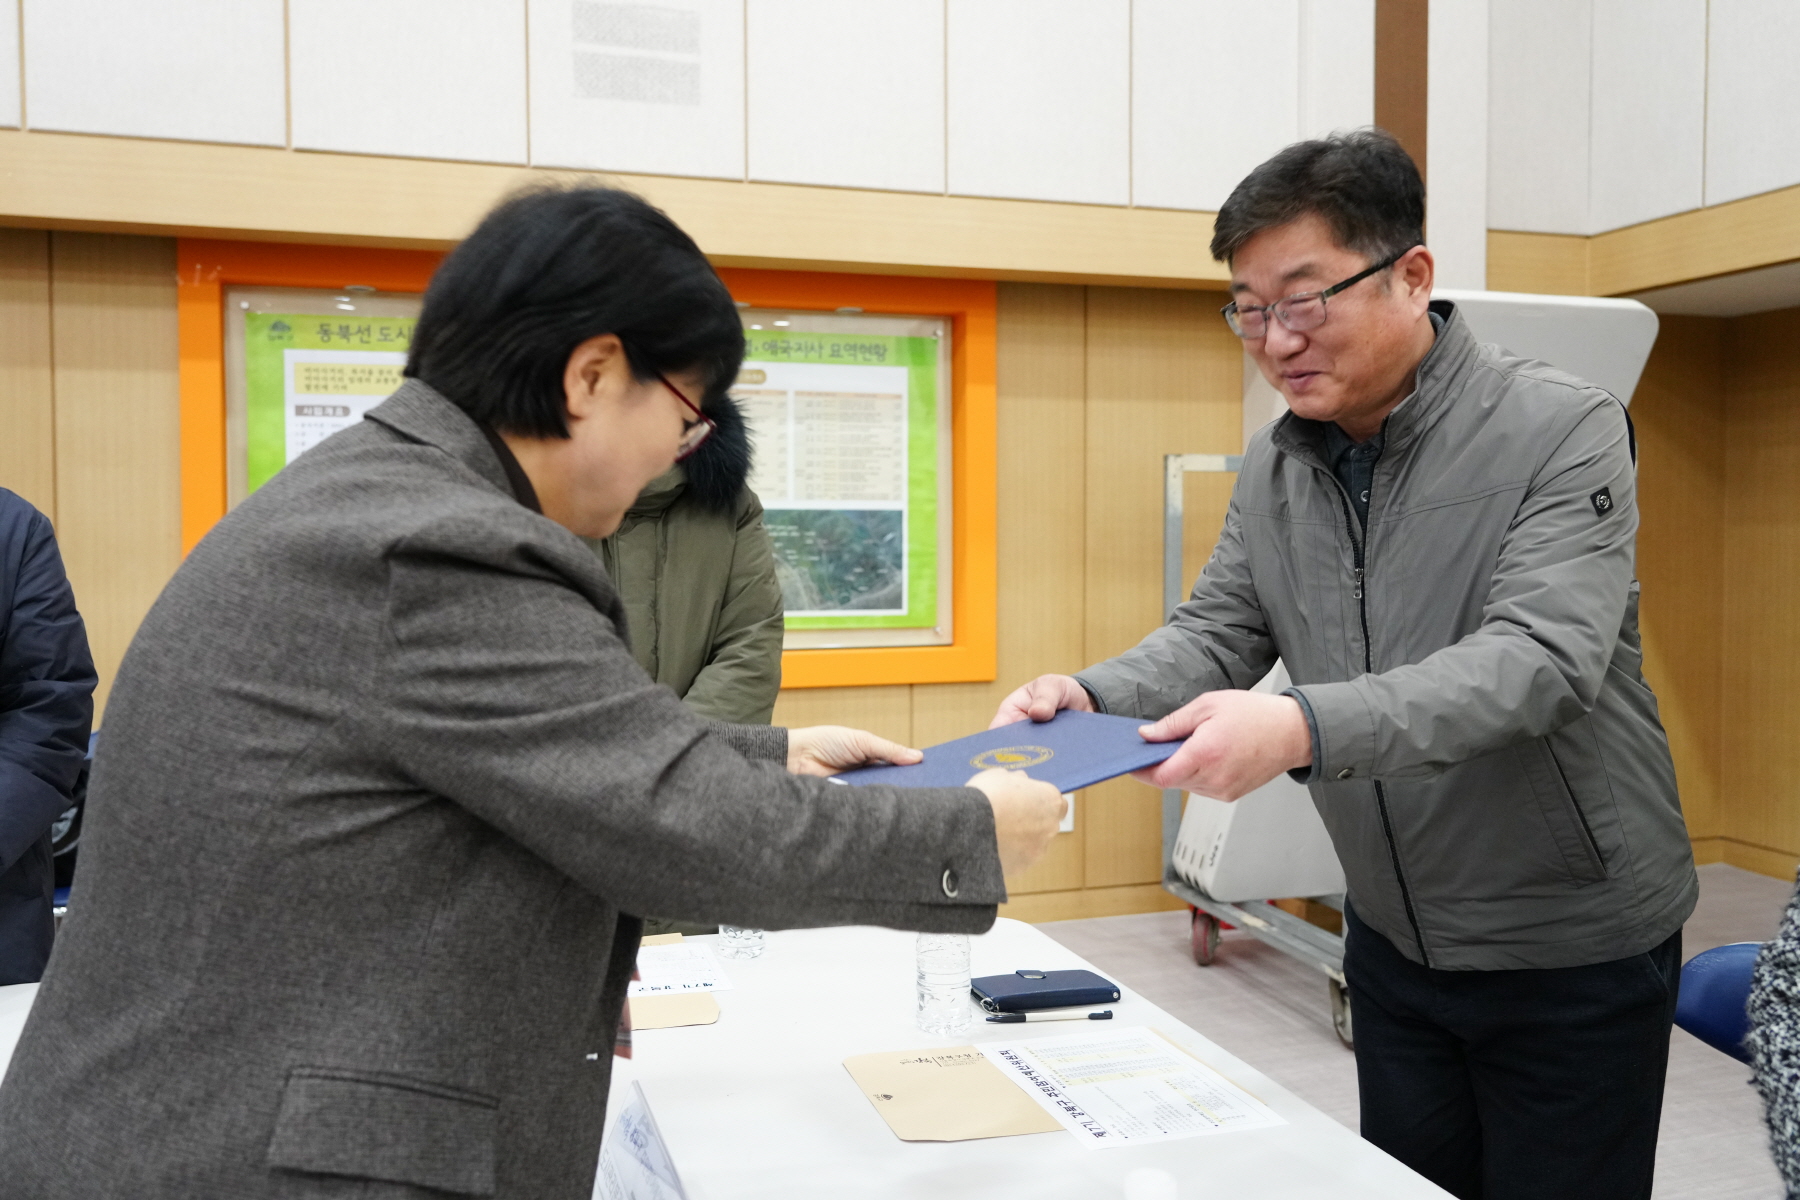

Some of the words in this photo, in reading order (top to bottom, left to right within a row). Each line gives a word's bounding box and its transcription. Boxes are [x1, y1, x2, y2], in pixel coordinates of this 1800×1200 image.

[317, 323, 371, 344] 동북선
[999, 1049, 1060, 1098] 주민참여예산위원회
[1056, 1099, 1085, 1119] 강북구
[1080, 1120, 1107, 1139] 제7기
